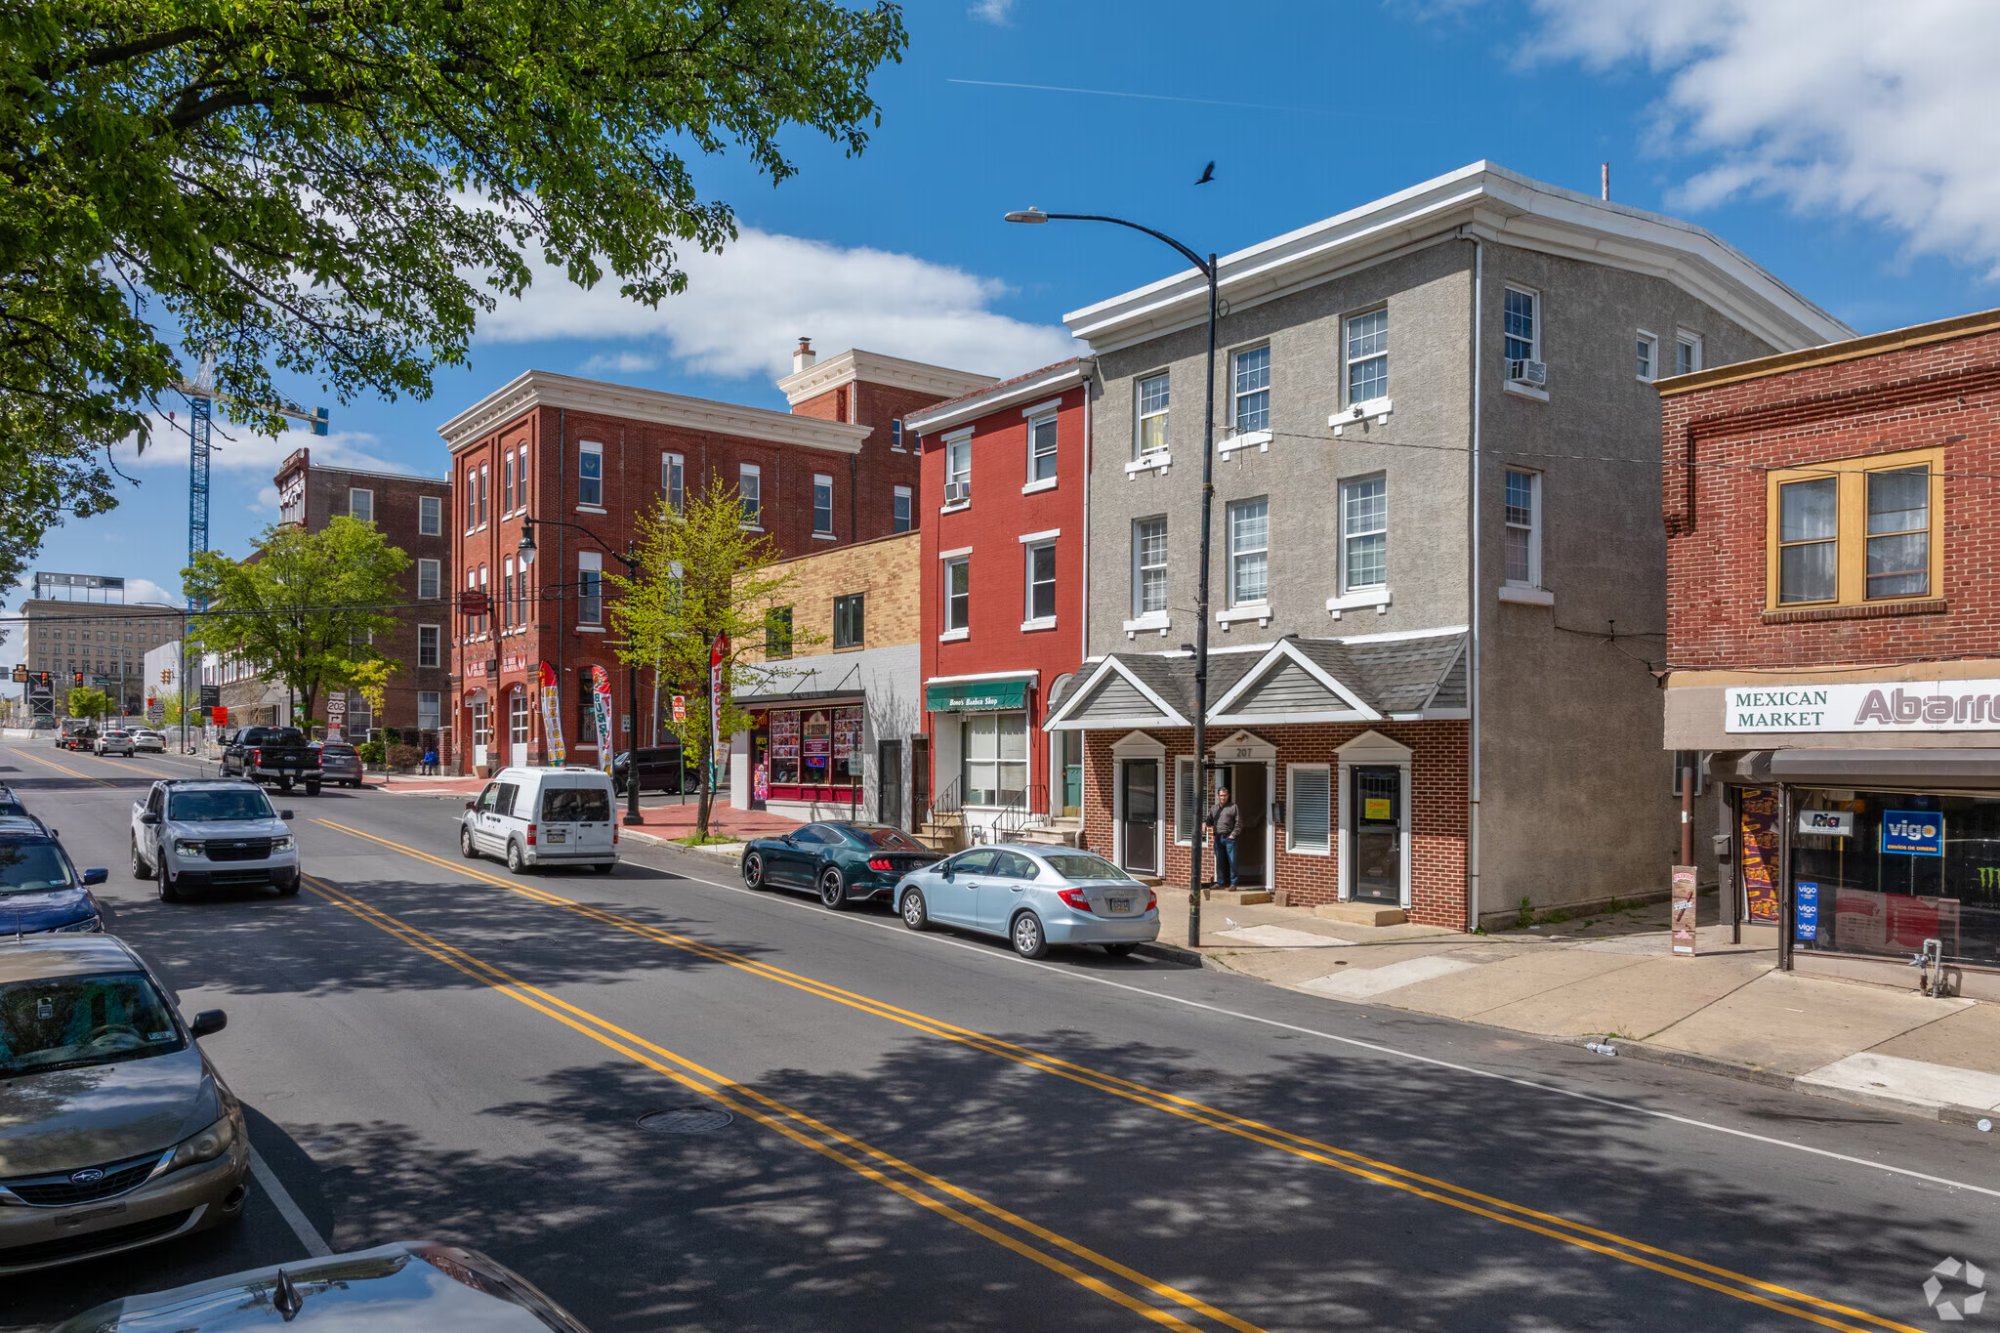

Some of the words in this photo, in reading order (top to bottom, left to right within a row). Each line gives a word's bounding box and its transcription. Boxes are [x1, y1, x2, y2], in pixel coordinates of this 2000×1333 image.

[984, 697, 998, 706] Shop
[1735, 690, 1828, 707] MEXICAN
[328, 702, 345, 710] 202
[1738, 711, 1825, 727] MARKET
[1237, 748, 1253, 758] 207
[1812, 813, 1841, 828] Ria
[1888, 820, 1937, 841] vigo
[1798, 885, 1816, 894] vigo
[1798, 904, 1816, 913] vigo
[1798, 923, 1816, 932] vigo
